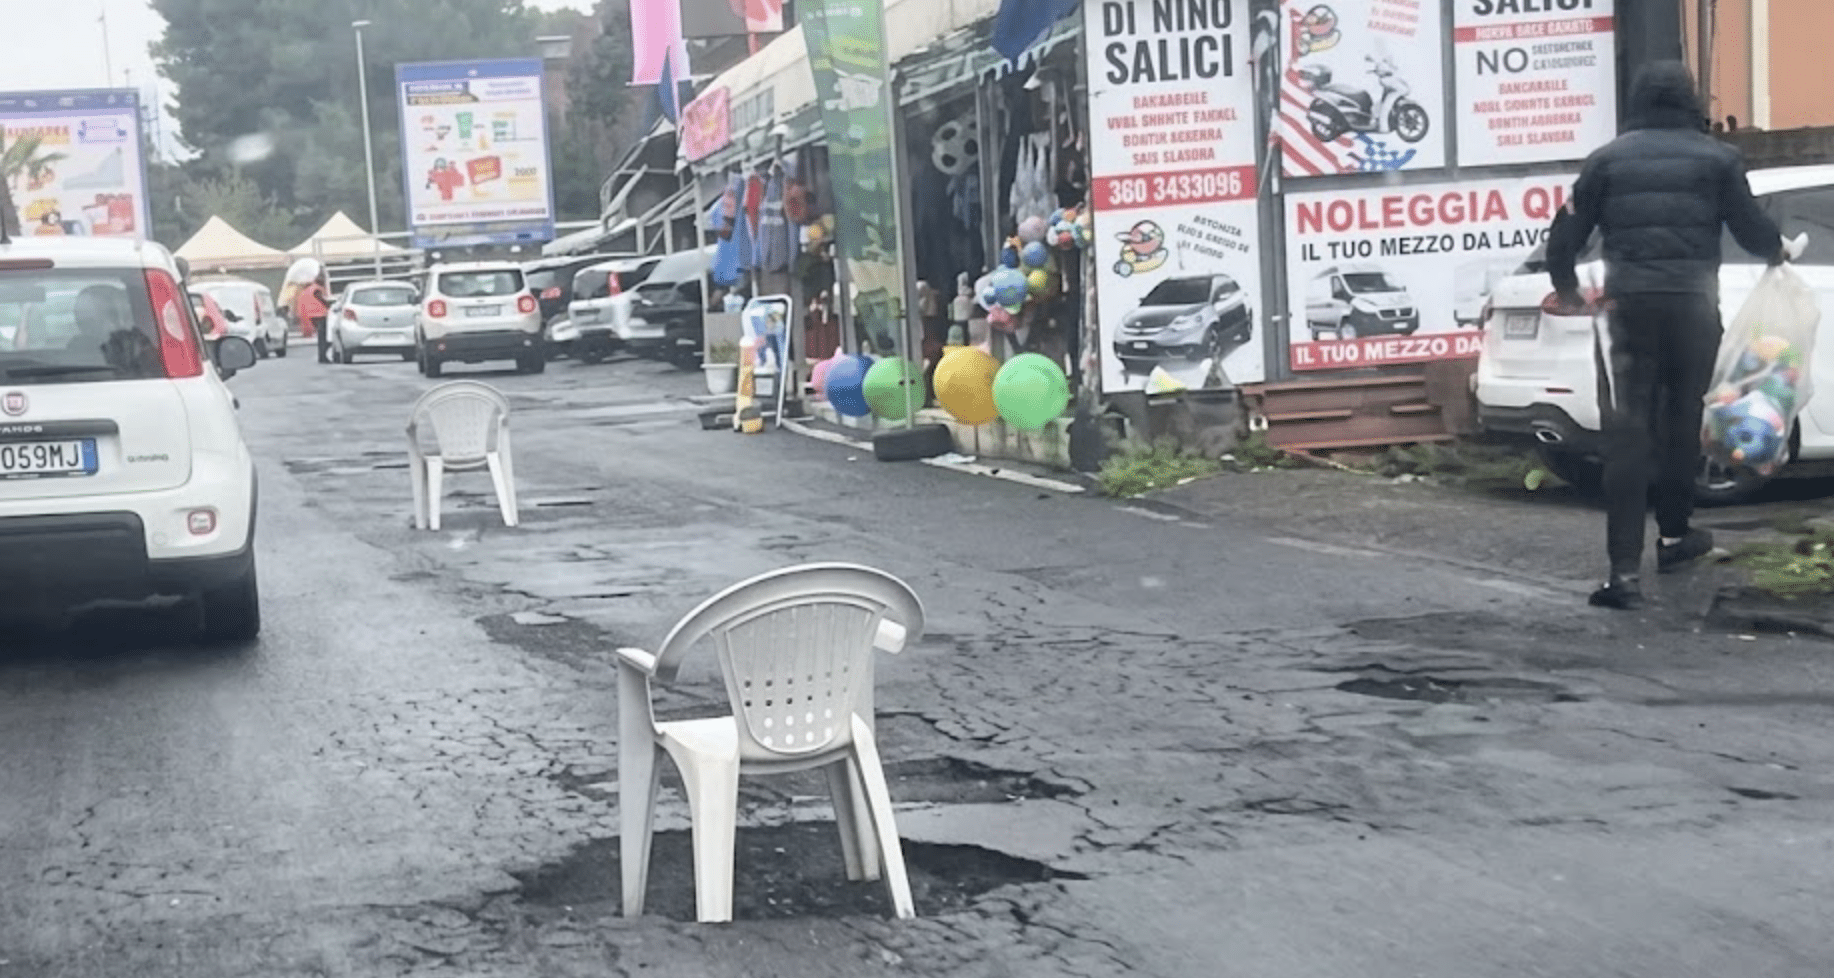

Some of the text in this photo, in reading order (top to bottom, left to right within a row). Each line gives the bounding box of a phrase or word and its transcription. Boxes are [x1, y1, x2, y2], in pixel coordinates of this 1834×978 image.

[1103, 0, 1231, 36] DI NINO
[1105, 34, 1233, 84] SALICI
[1477, 48, 1528, 75] NO
[1109, 171, 1242, 204] 360 3433096
[1297, 189, 1509, 234] NOLEGGIA
[1302, 244, 1320, 261] IL
[1328, 240, 1372, 259] TUO
[1381, 234, 1454, 256] MEZZO
[1463, 232, 1491, 250] DA
[1296, 336, 1484, 364] IL TUO MEZZO DA
[1, 444, 79, 470] 059MJ
